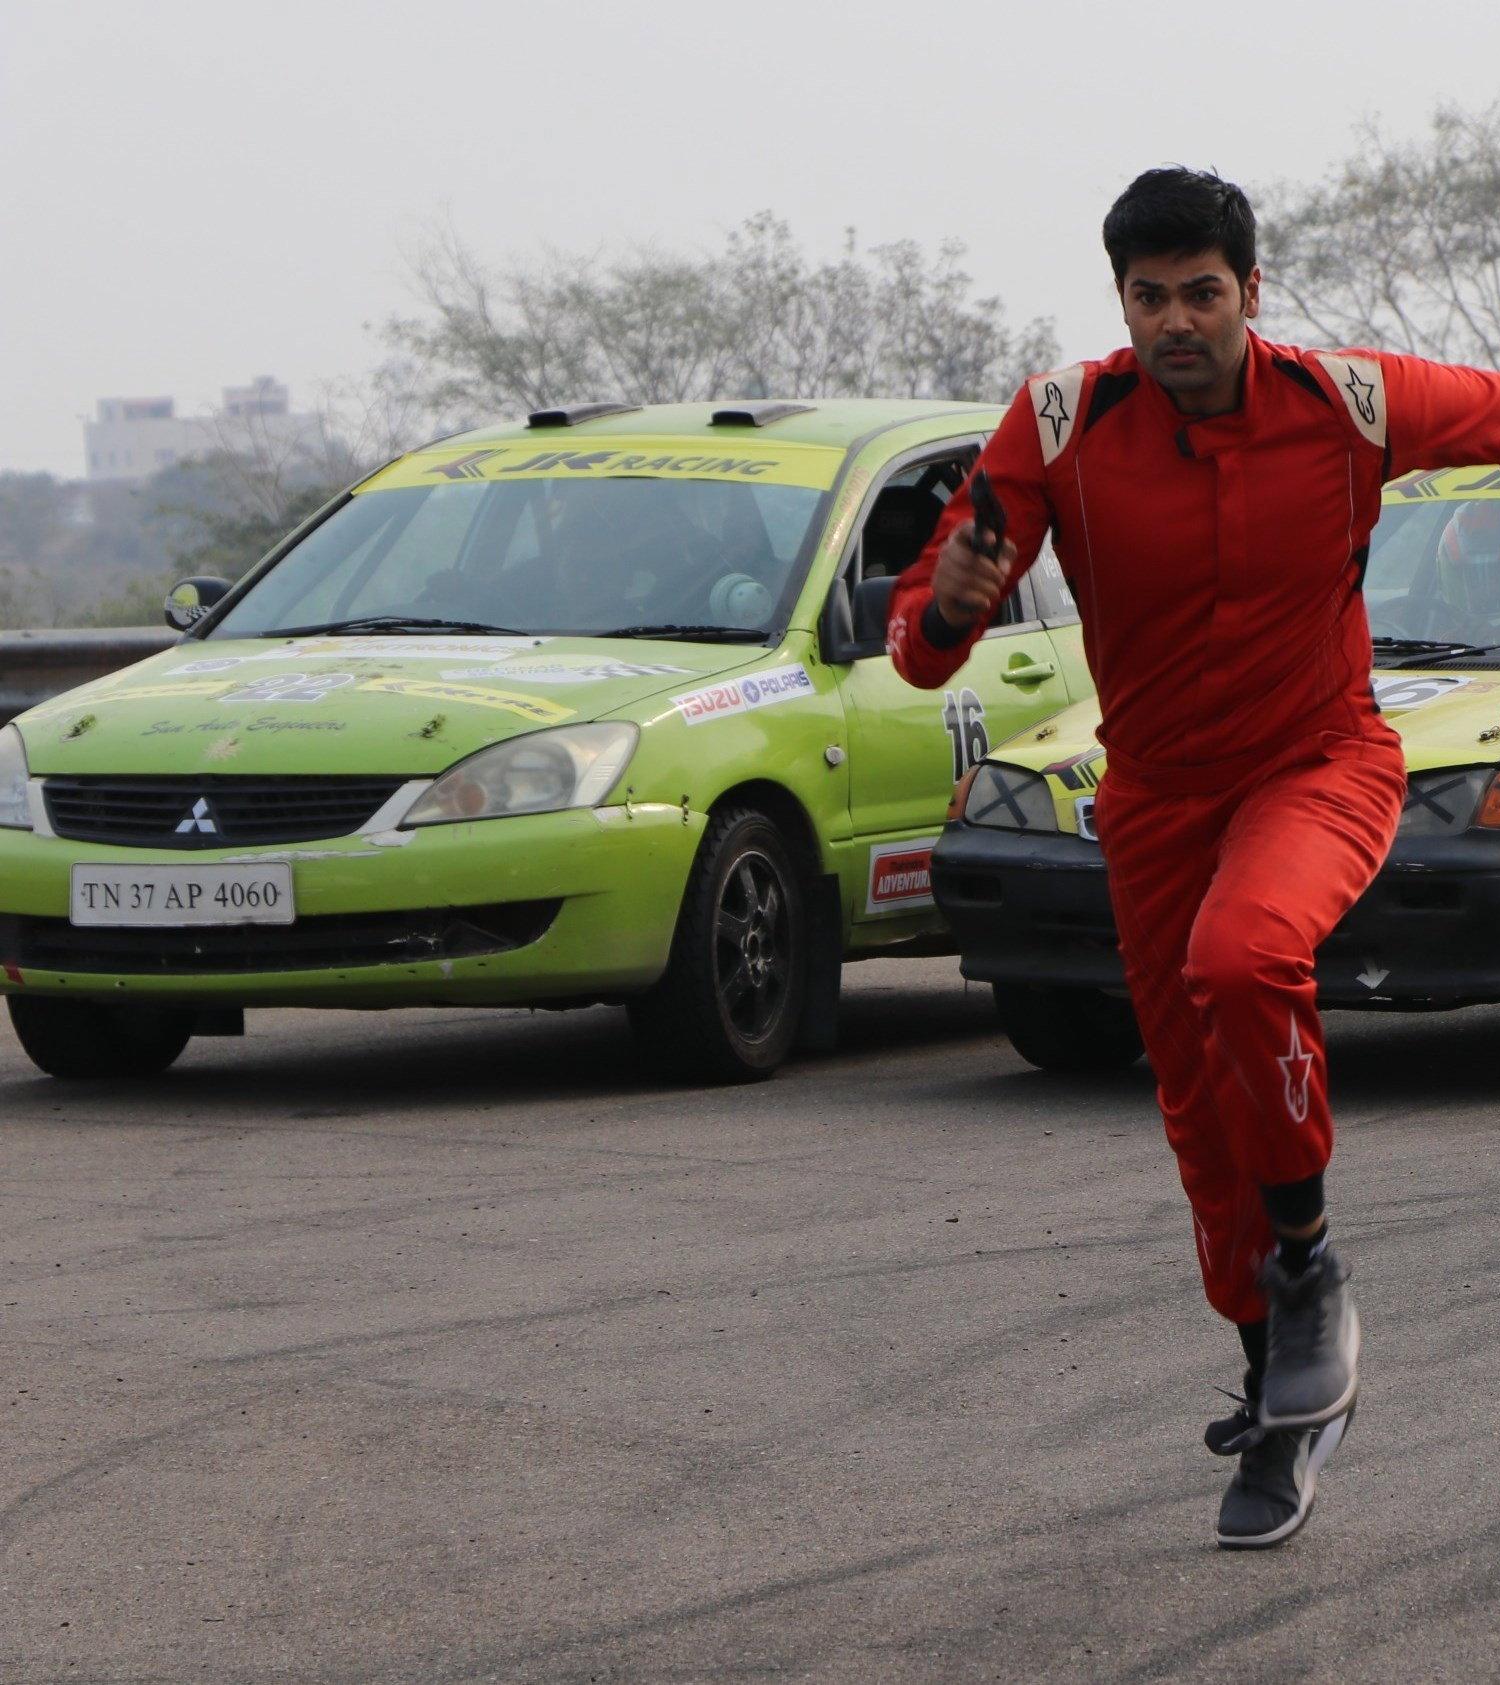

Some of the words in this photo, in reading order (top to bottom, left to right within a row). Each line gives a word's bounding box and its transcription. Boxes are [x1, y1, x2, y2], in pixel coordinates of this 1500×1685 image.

[498, 450, 623, 473] JK
[606, 455, 782, 476] RACING
[218, 673, 356, 702] 22
[758, 668, 810, 697] POLARIS
[1369, 678, 1460, 707] 6
[678, 685, 741, 718] ISUZU
[942, 687, 990, 784] 16
[83, 882, 121, 909] TN
[130, 883, 155, 909] 37
[164, 883, 202, 909] AP
[214, 881, 278, 908] 4060
